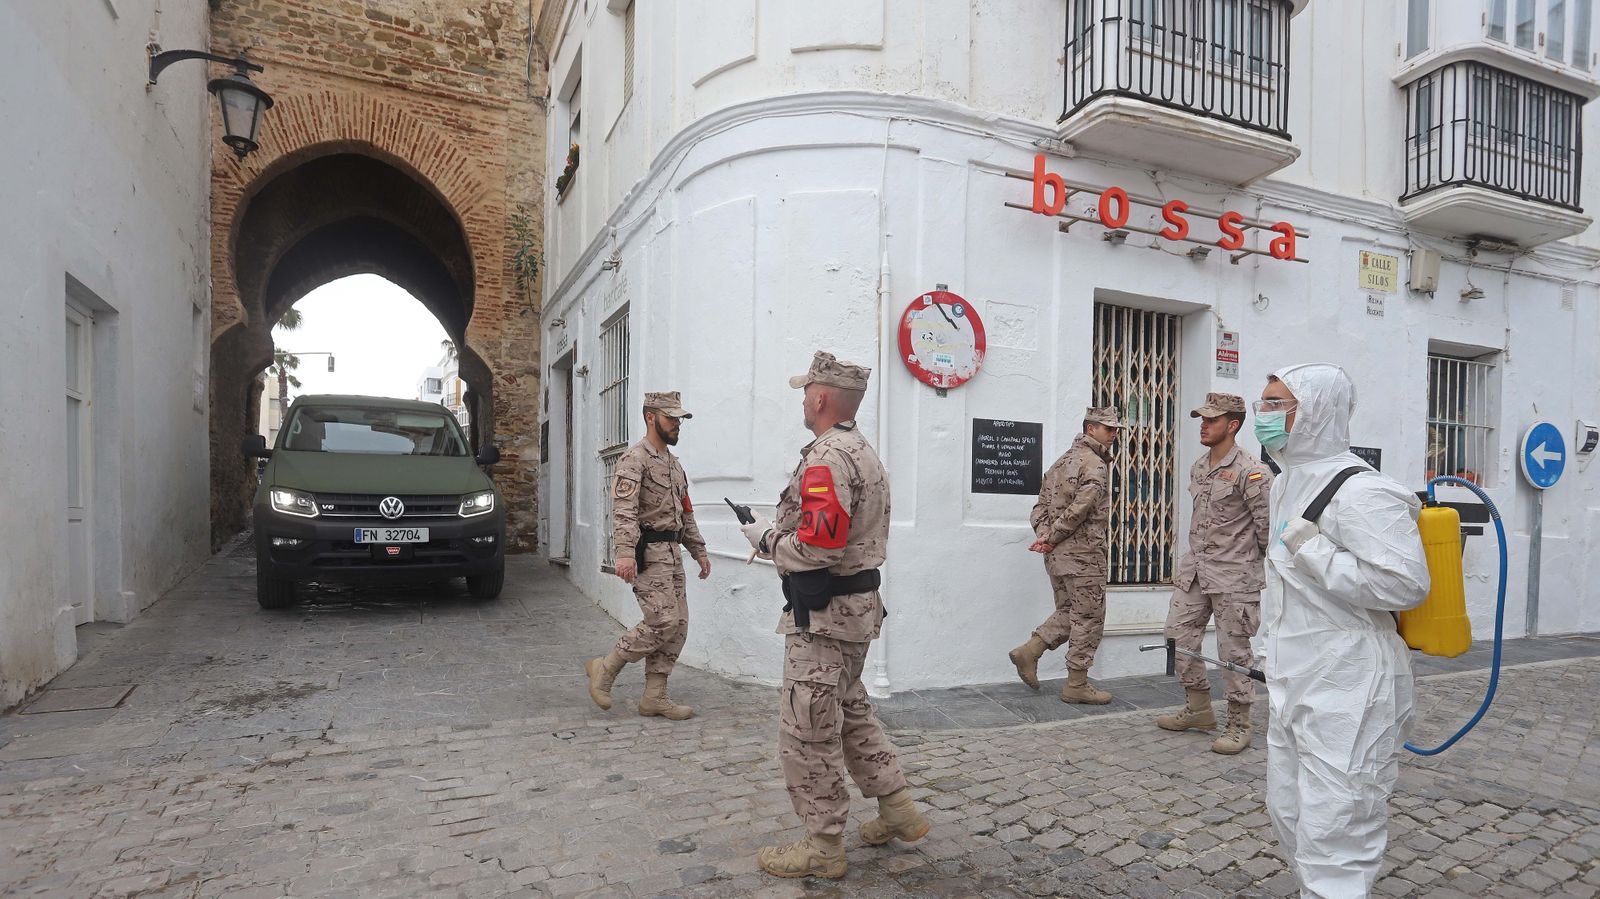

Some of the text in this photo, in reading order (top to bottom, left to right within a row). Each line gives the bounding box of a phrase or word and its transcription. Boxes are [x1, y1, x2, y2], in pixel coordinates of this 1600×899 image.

[1032, 153, 1296, 261] bossa
[1371, 257, 1392, 271] CALLE
[1367, 273, 1389, 287] SILOS
[362, 529, 421, 541] FN 32704
